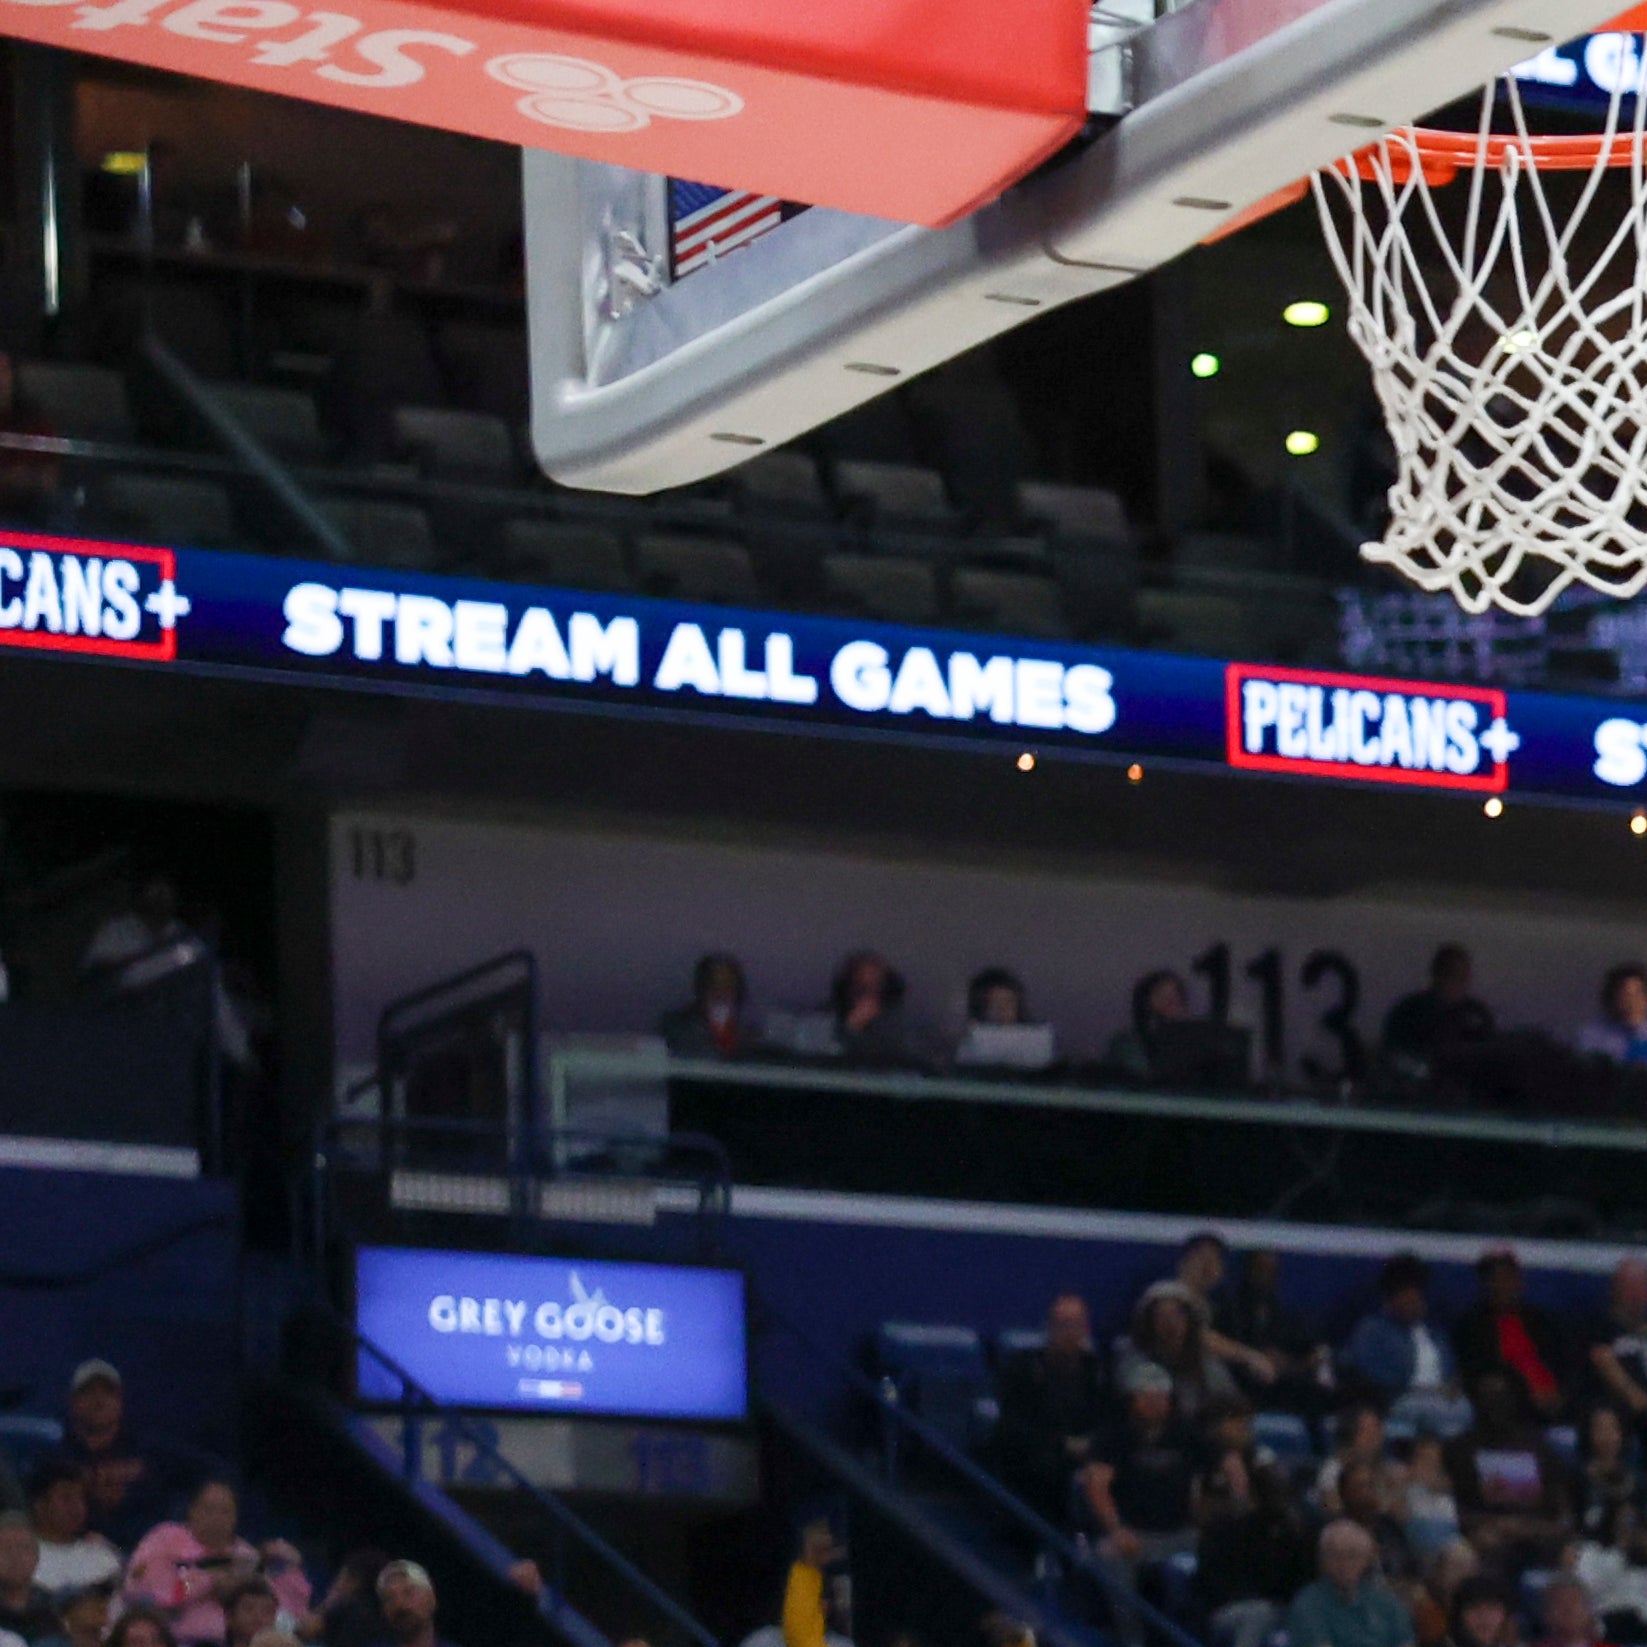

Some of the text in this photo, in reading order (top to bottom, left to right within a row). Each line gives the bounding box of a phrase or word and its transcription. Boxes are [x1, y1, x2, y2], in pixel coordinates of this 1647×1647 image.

[283, 583, 1116, 734] STREAM ALL GAMES
[1243, 679, 1519, 775] PELICANS+
[428, 1294, 666, 1346] GREY GOOSE
[506, 1344, 596, 1373] VODKA
